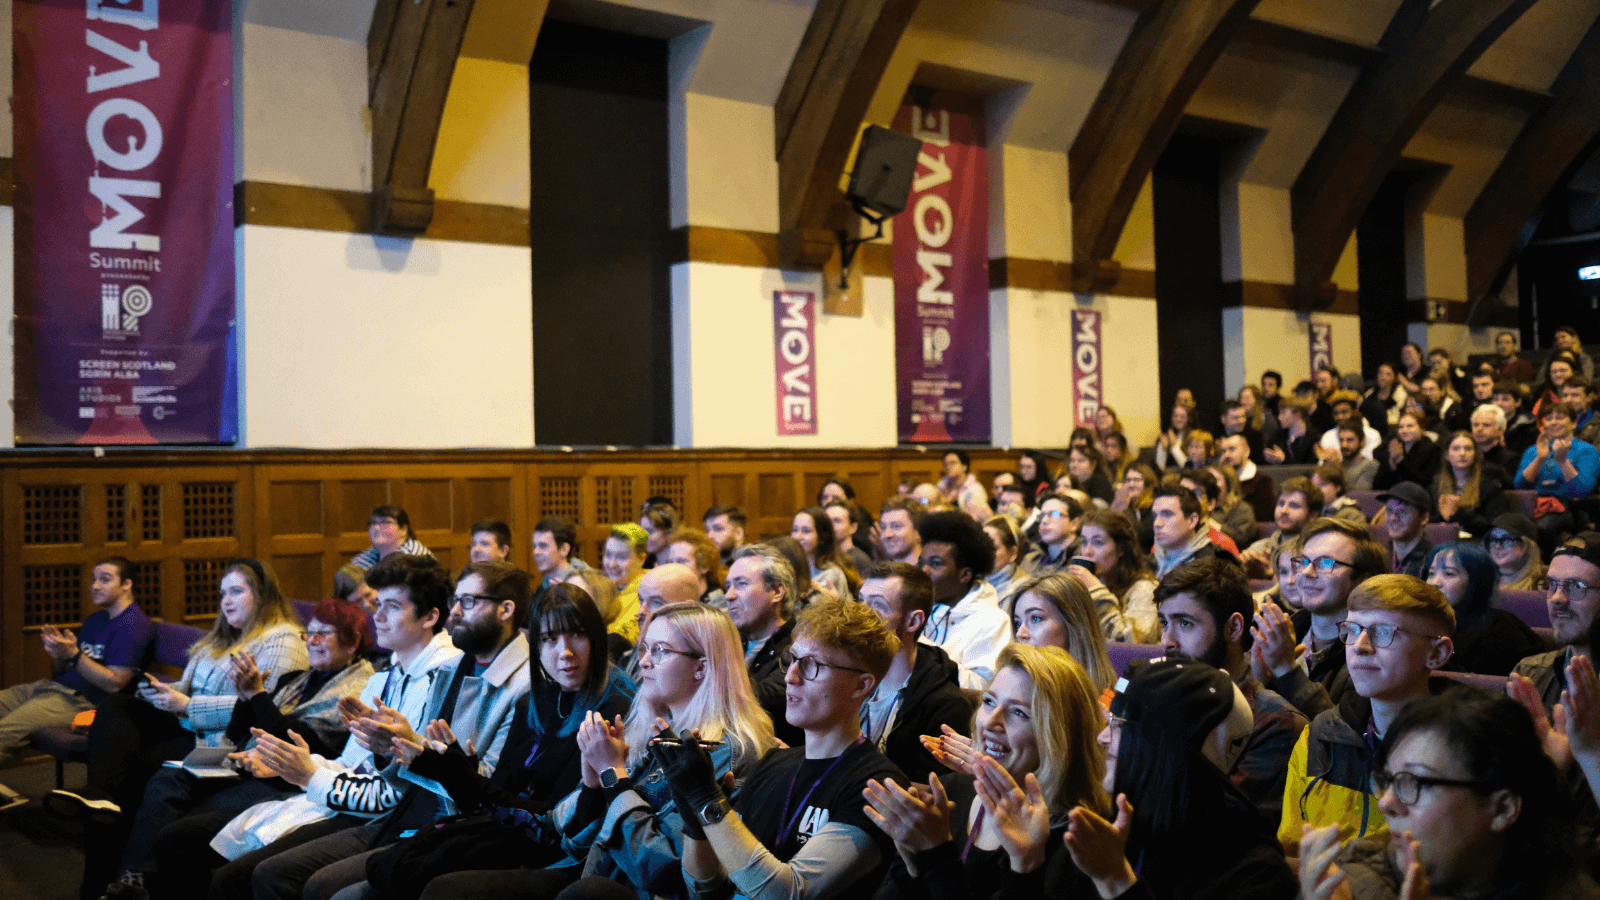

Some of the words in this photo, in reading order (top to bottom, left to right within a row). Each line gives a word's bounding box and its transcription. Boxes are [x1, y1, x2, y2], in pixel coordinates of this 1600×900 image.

[913, 106, 954, 305] MOVE
[89, 252, 161, 272] Summit
[79, 359, 120, 369] SCREEN
[122, 360, 177, 371] SCOTLAND
[781, 294, 811, 422] MOVE
[1076, 312, 1099, 423] MOVE
